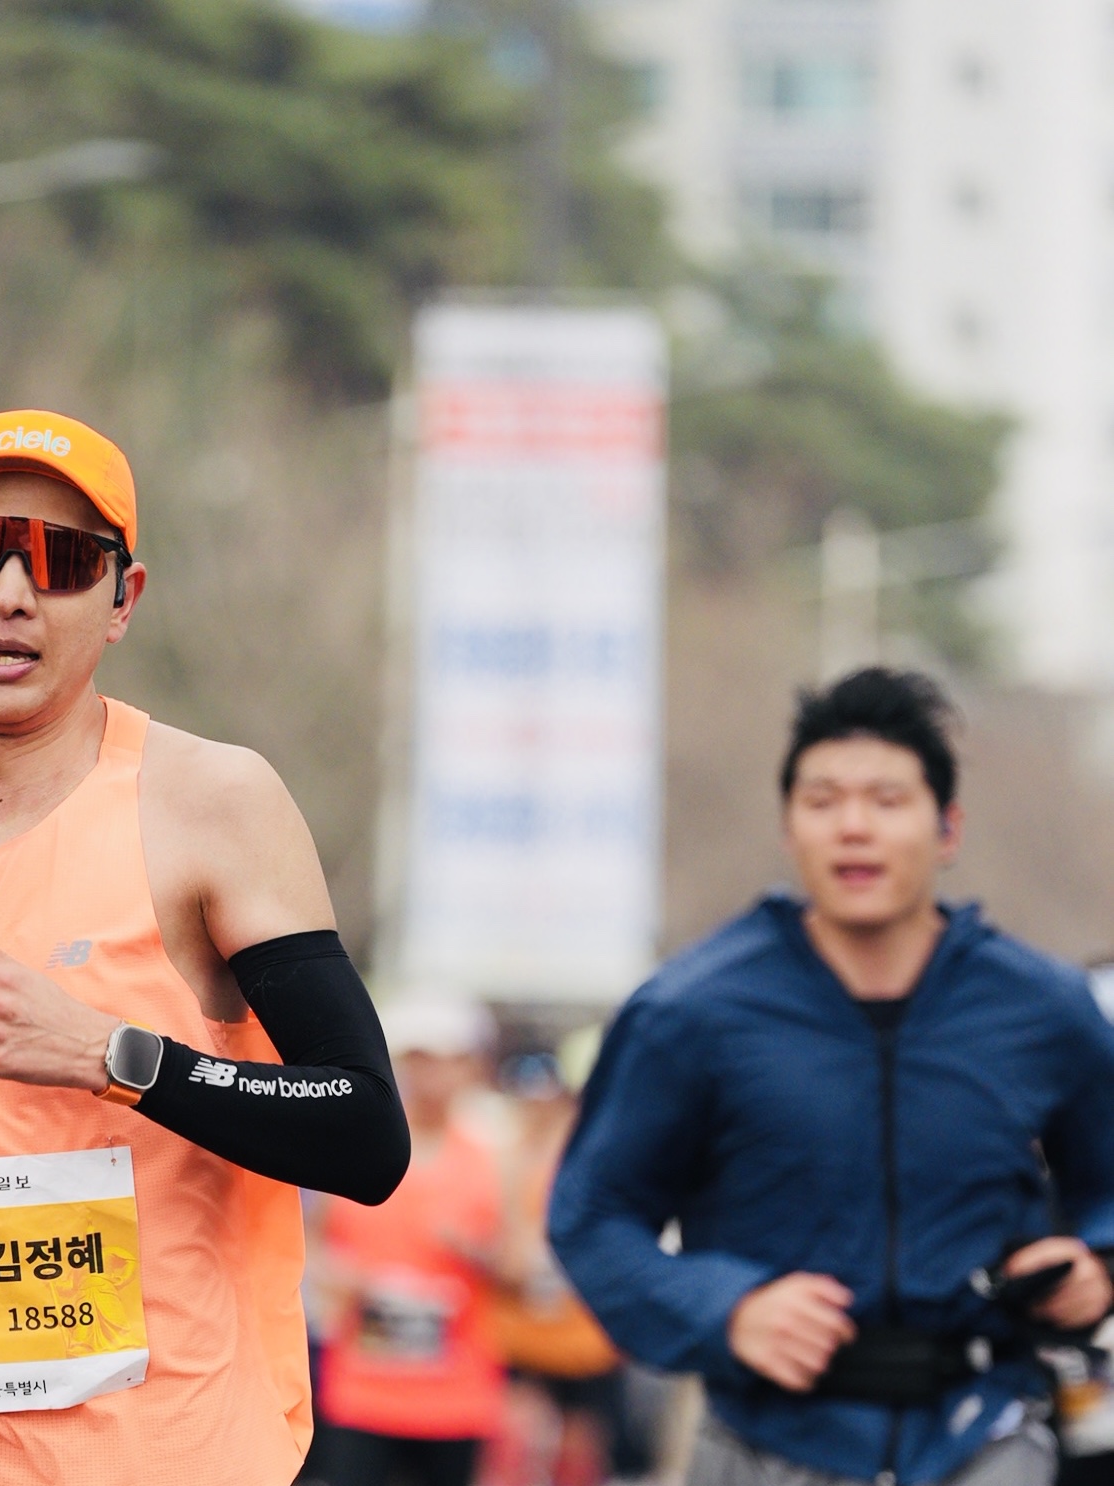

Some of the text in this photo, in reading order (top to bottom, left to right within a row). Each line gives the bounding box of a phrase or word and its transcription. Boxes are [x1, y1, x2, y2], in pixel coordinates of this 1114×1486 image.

[238, 1077, 277, 1096] new
[279, 1077, 353, 1098] balance
[8, 1302, 95, 1332] 18588
